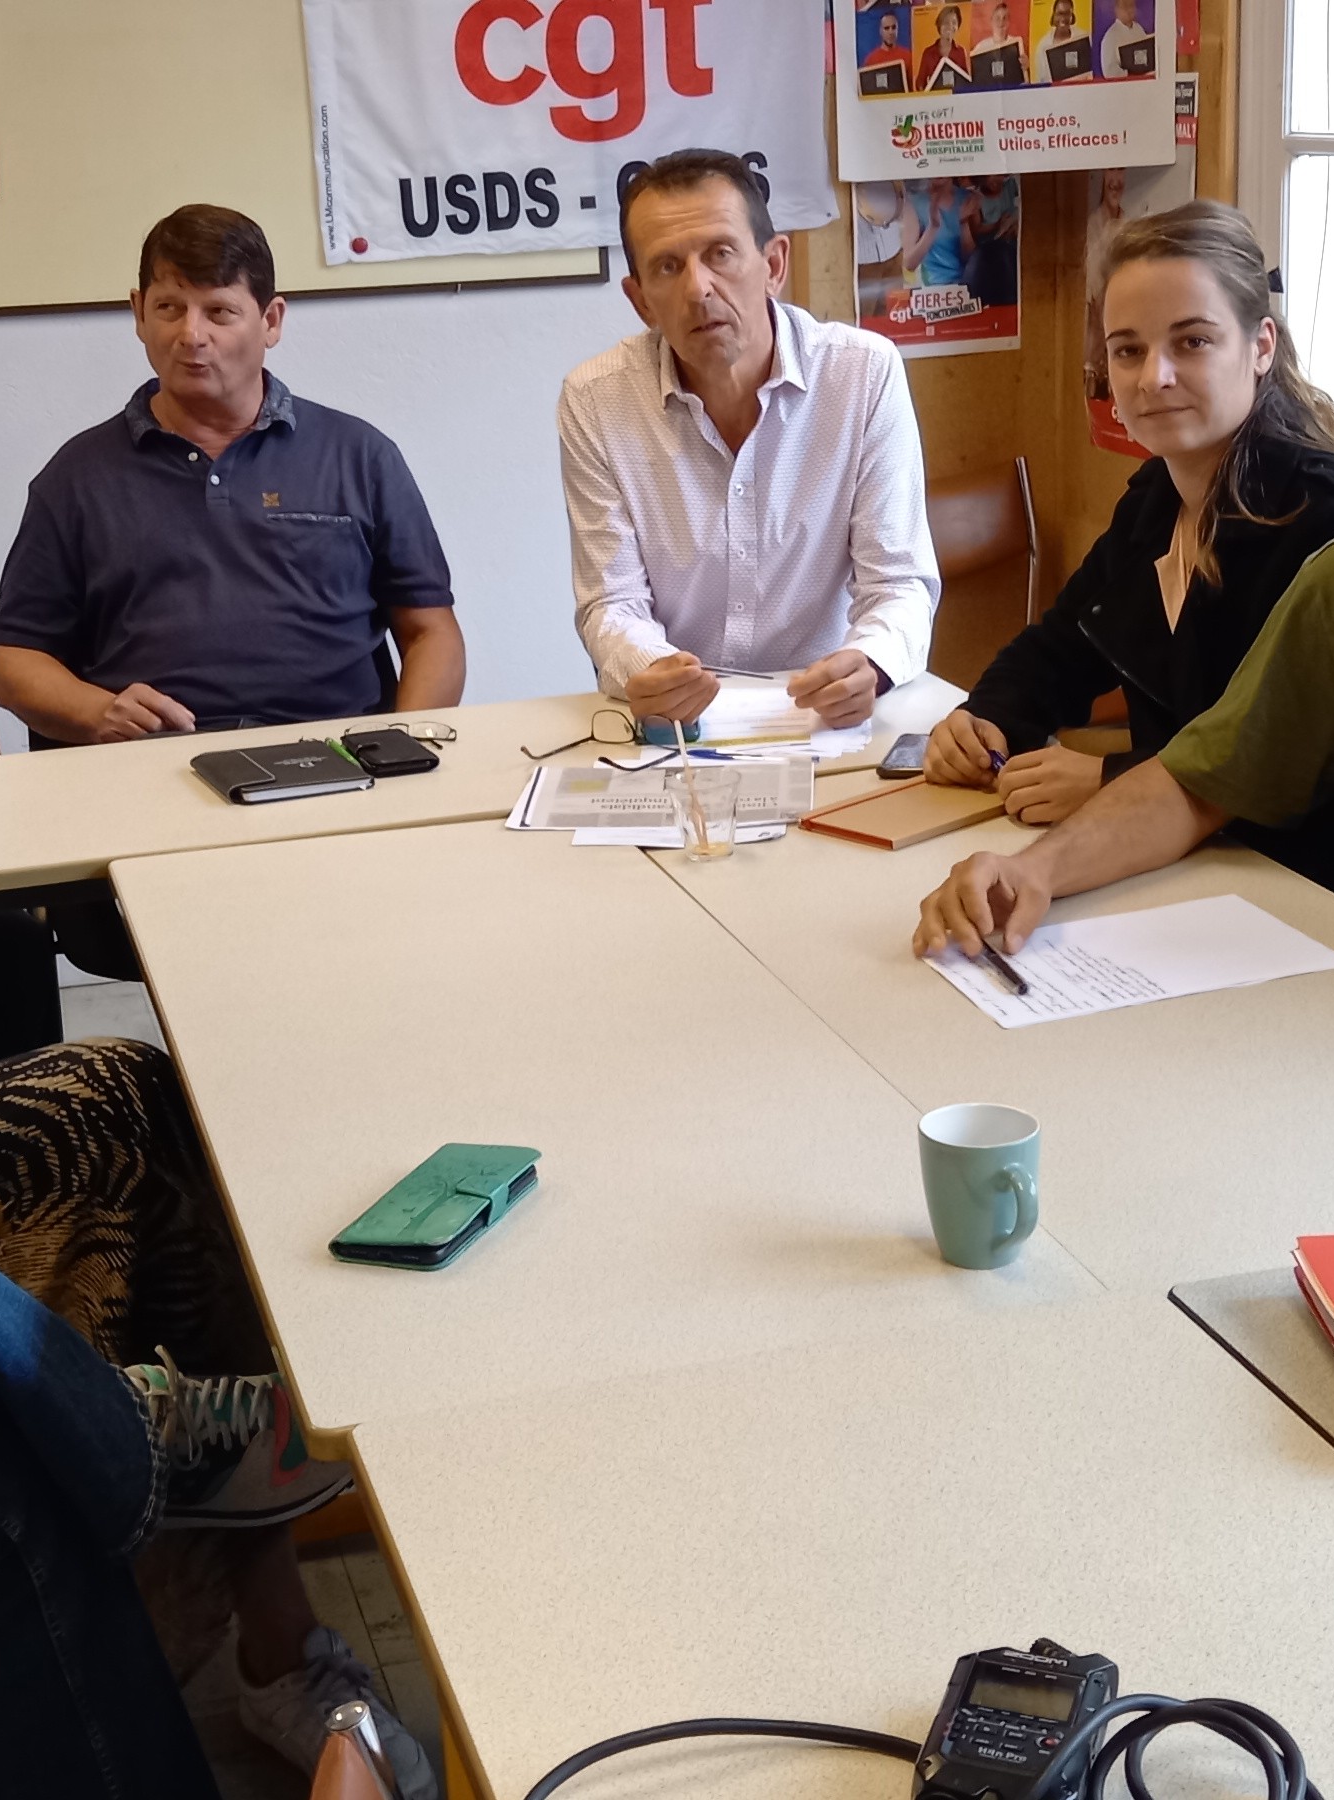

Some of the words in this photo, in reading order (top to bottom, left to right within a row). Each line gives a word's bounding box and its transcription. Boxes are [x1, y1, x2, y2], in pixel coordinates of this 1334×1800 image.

[455, 0, 713, 142] cgt
[924, 120, 984, 140] ÉLECTION
[998, 136, 1045, 152] Utiles,
[1048, 133, 1119, 149] Efficaces
[399, 167, 561, 238] USDS
[889, 306, 912, 323] cgt
[1003, 1650, 1068, 1667] ZOOM
